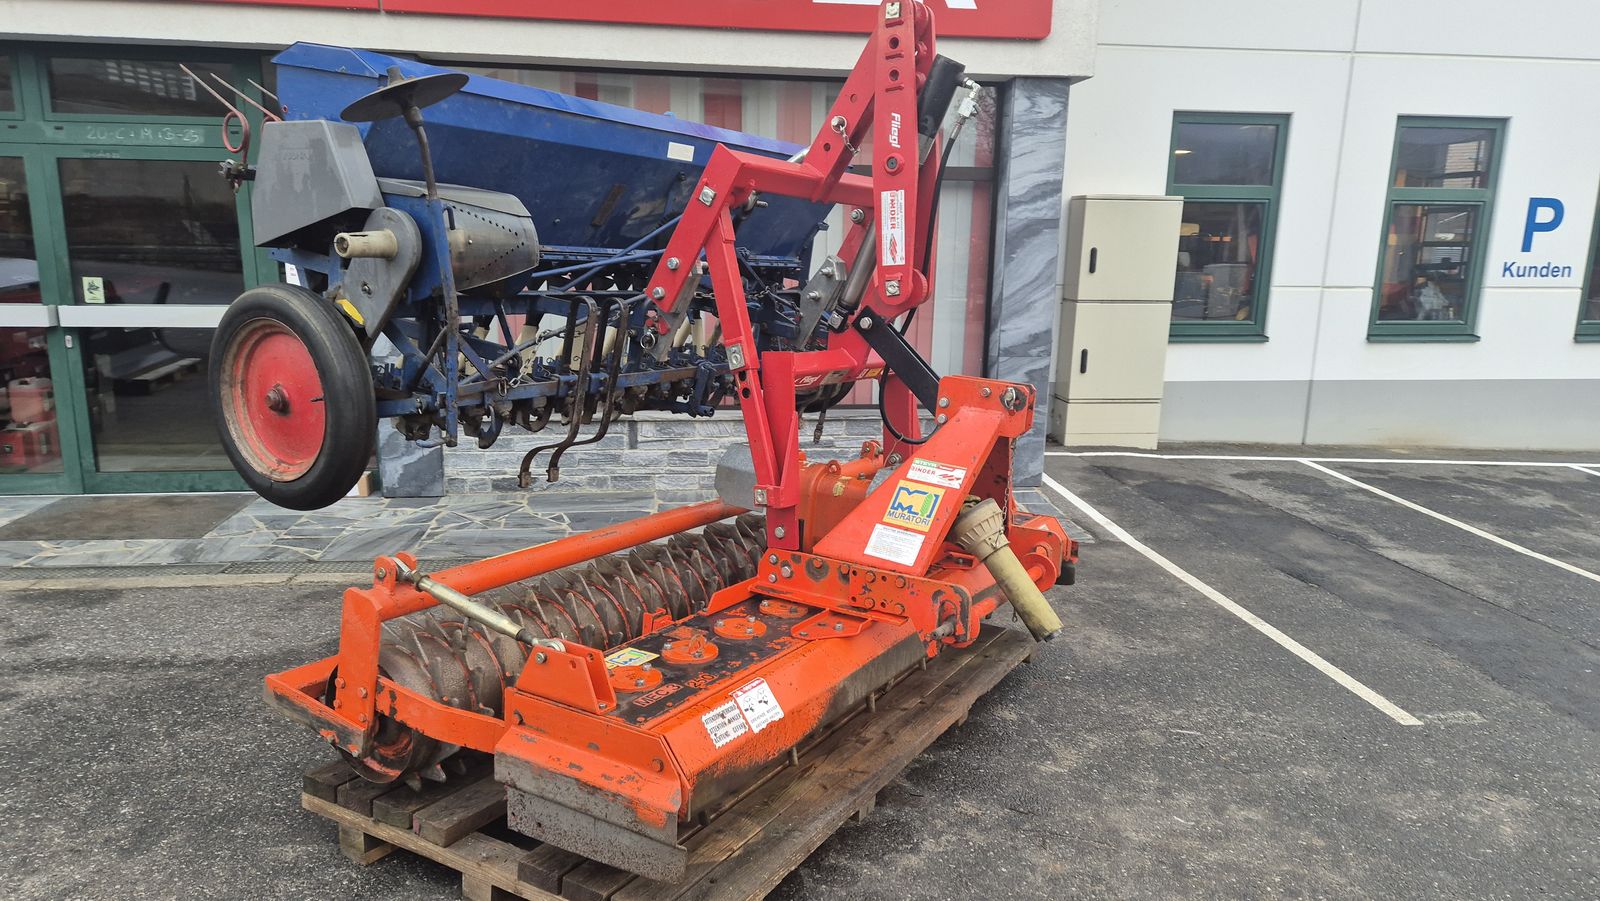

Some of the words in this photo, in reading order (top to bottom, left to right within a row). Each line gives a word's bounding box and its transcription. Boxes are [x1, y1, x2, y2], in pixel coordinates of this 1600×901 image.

[889, 112, 901, 148] Fliegl
[1521, 197, 1565, 252] P
[1502, 261, 1572, 278] Kunden
[886, 510, 931, 526] MURATORI
[634, 688, 670, 707] MEC
